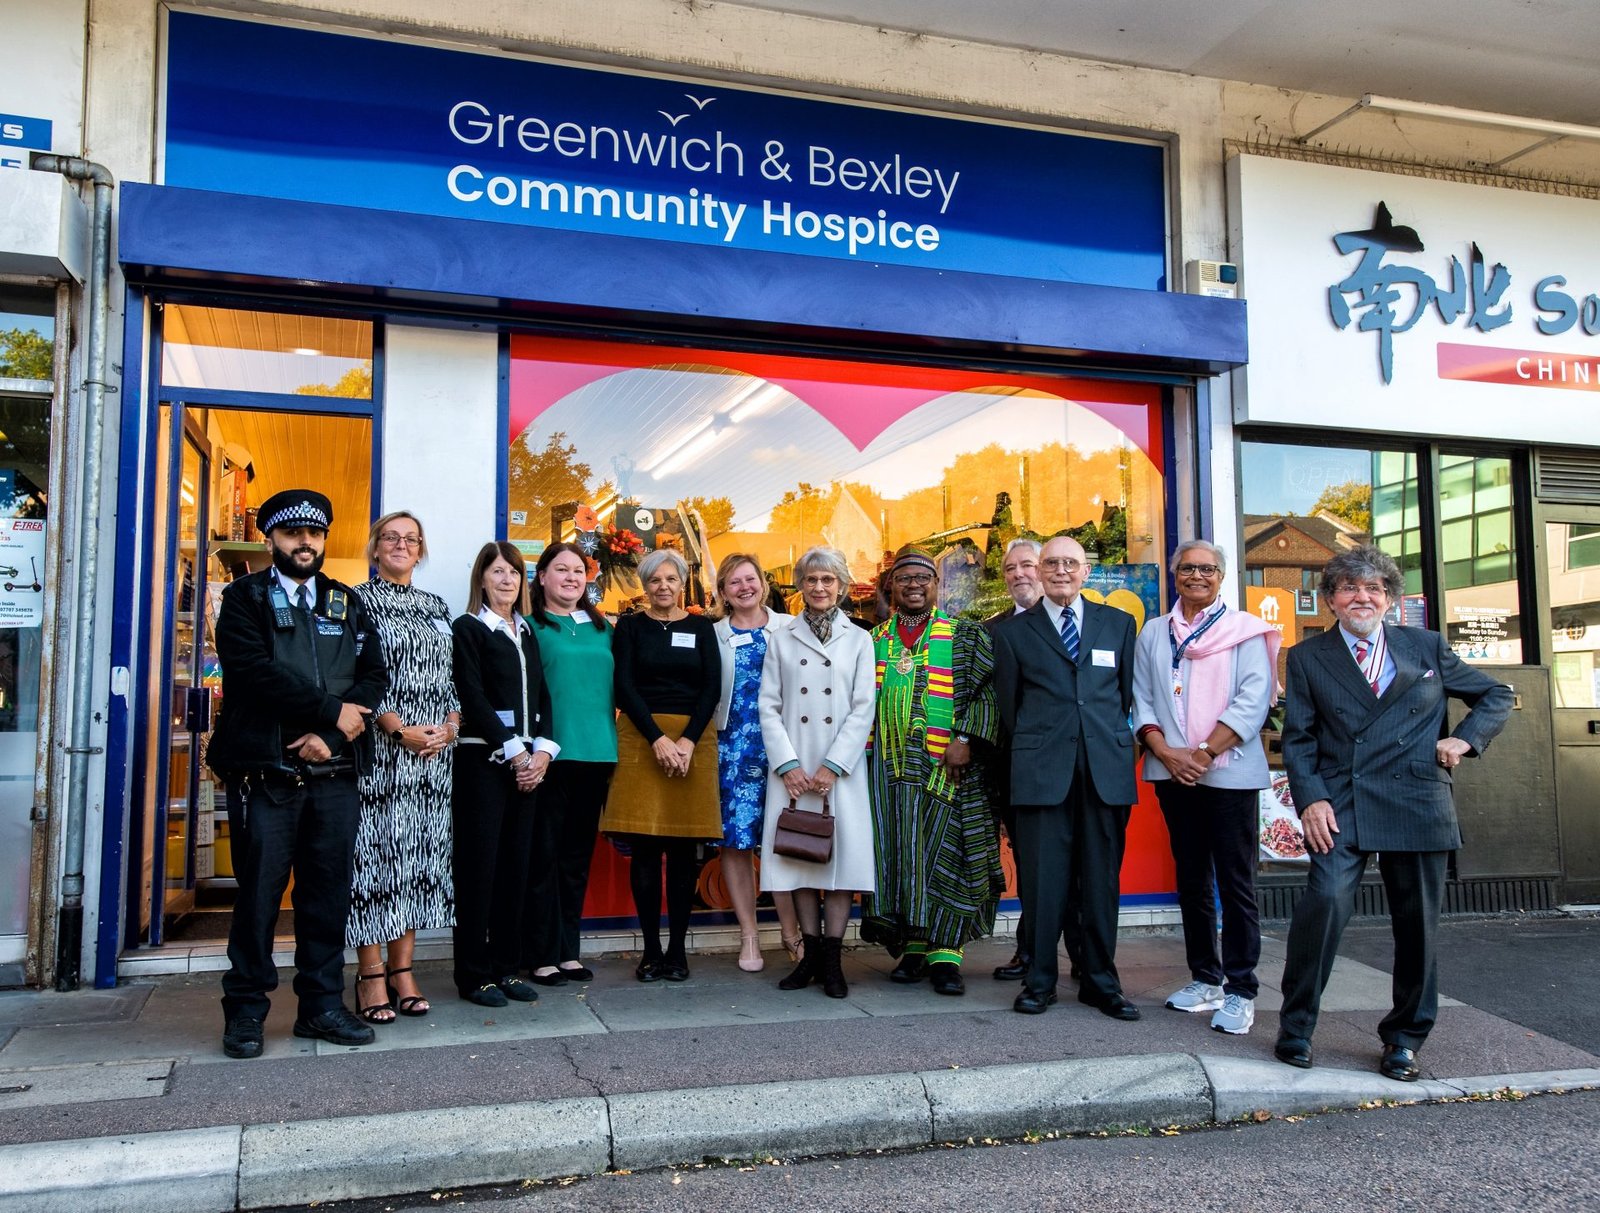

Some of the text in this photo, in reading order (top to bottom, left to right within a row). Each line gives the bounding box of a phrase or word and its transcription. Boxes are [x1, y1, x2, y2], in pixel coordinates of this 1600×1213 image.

[0, 123, 24, 140] S
[448, 100, 961, 214] Greenwich & Bexley
[446, 164, 940, 255] Community Hospice
[1516, 357, 1600, 385] CHIN
[12, 521, 44, 531] E-TREK
[1459, 628, 1481, 636] Monday
[1488, 629, 1508, 637] Sunday
